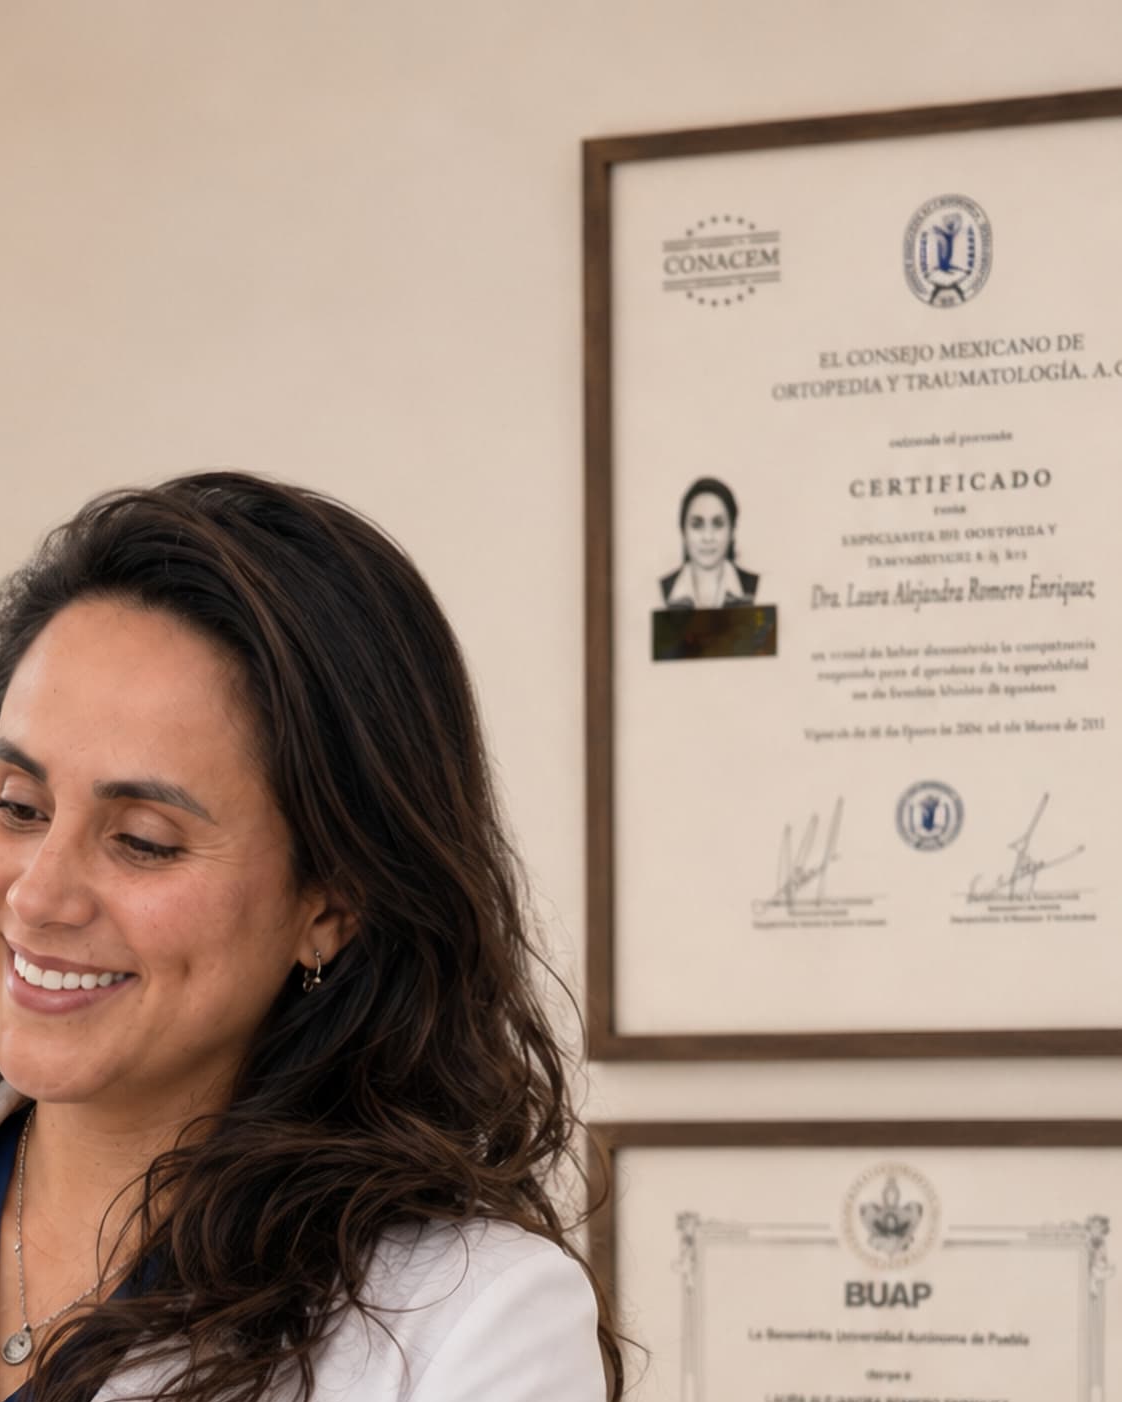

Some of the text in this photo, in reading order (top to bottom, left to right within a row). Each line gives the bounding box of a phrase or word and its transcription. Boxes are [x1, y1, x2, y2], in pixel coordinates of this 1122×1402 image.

[663, 247, 780, 275] CONACEM
[819, 333, 1085, 369] EL CONSEJO MEXICANO DE
[885, 375, 900, 393] Y
[849, 468, 1053, 499] CERTIFICADO
[967, 576, 1025, 603] Romero
[844, 1280, 933, 1309] BUAP
